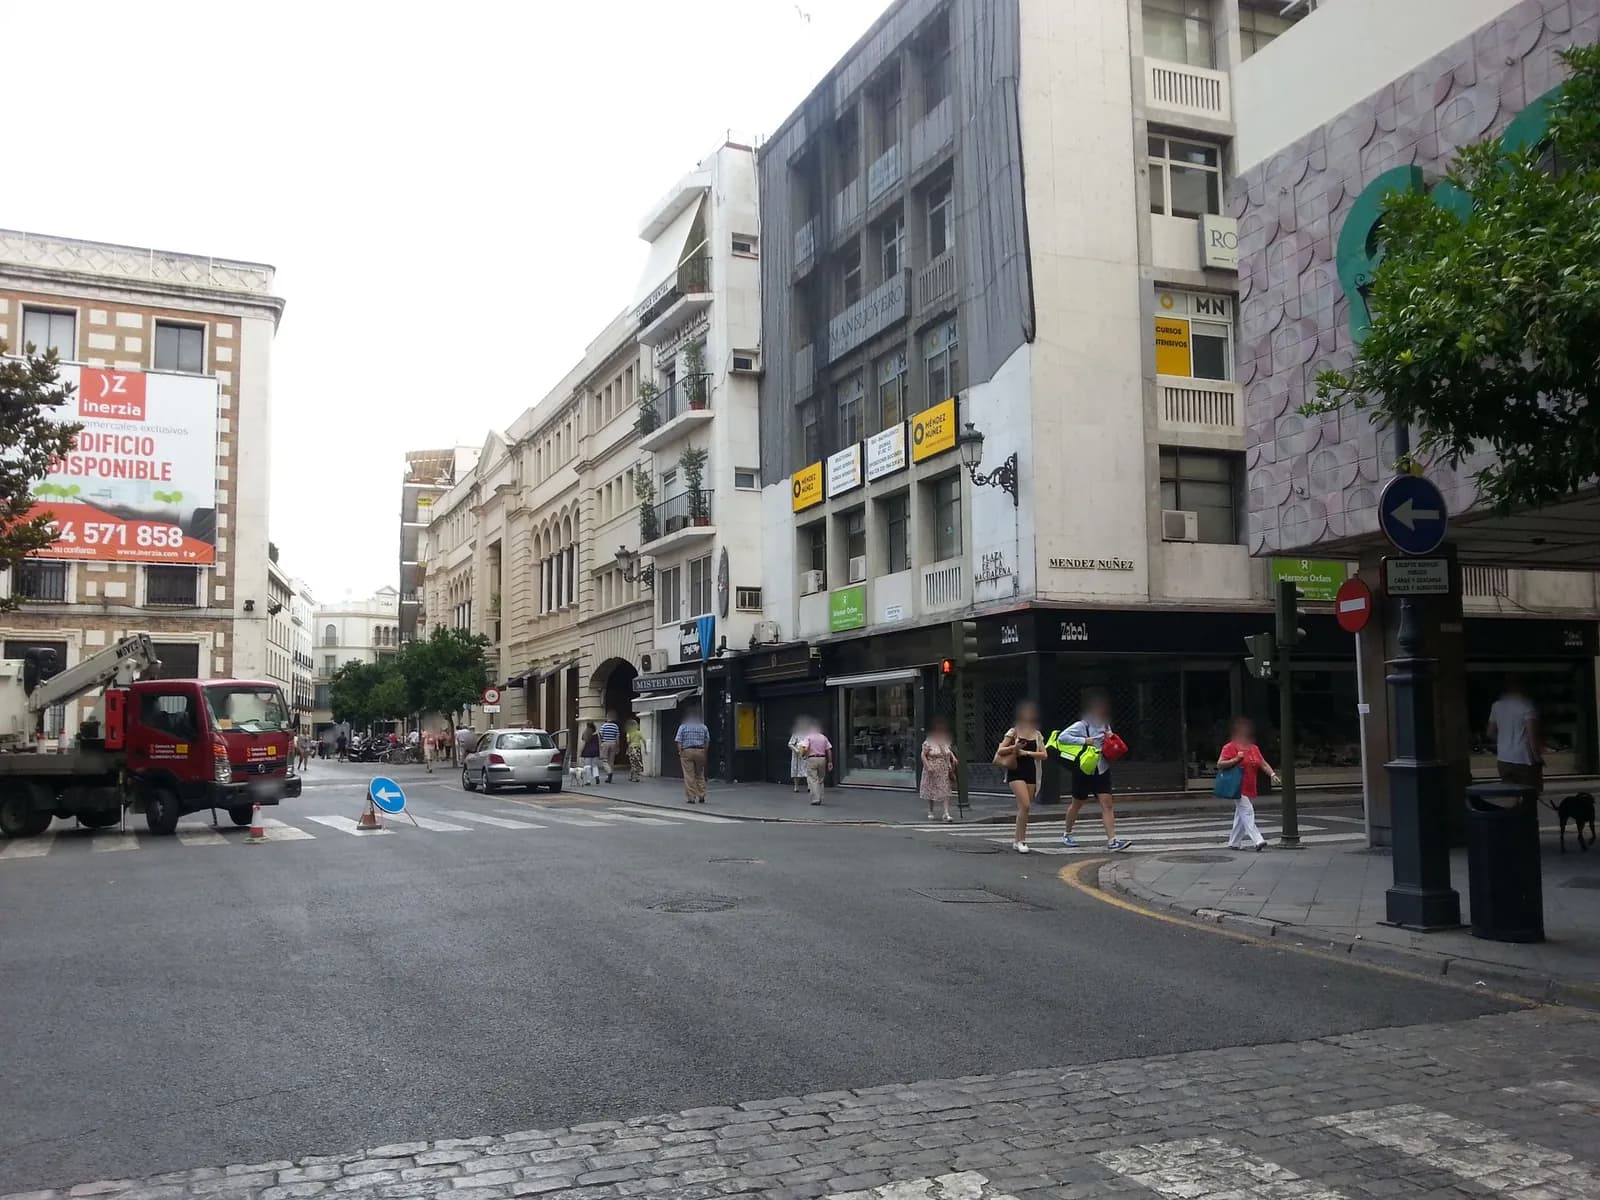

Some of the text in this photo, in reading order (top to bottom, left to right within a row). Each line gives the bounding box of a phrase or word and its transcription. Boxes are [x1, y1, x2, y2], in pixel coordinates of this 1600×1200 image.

[1197, 296, 1225, 316] MN
[1156, 326, 1182, 335] CURSOS
[83, 399, 142, 416] inerzia
[83, 522, 127, 545] 571
[136, 525, 183, 548] 858
[982, 551, 1002, 563] PLAZA
[1050, 557, 1133, 569] MENDEZ NUÑEZ
[636, 676, 695, 689] MISTER MINIT
